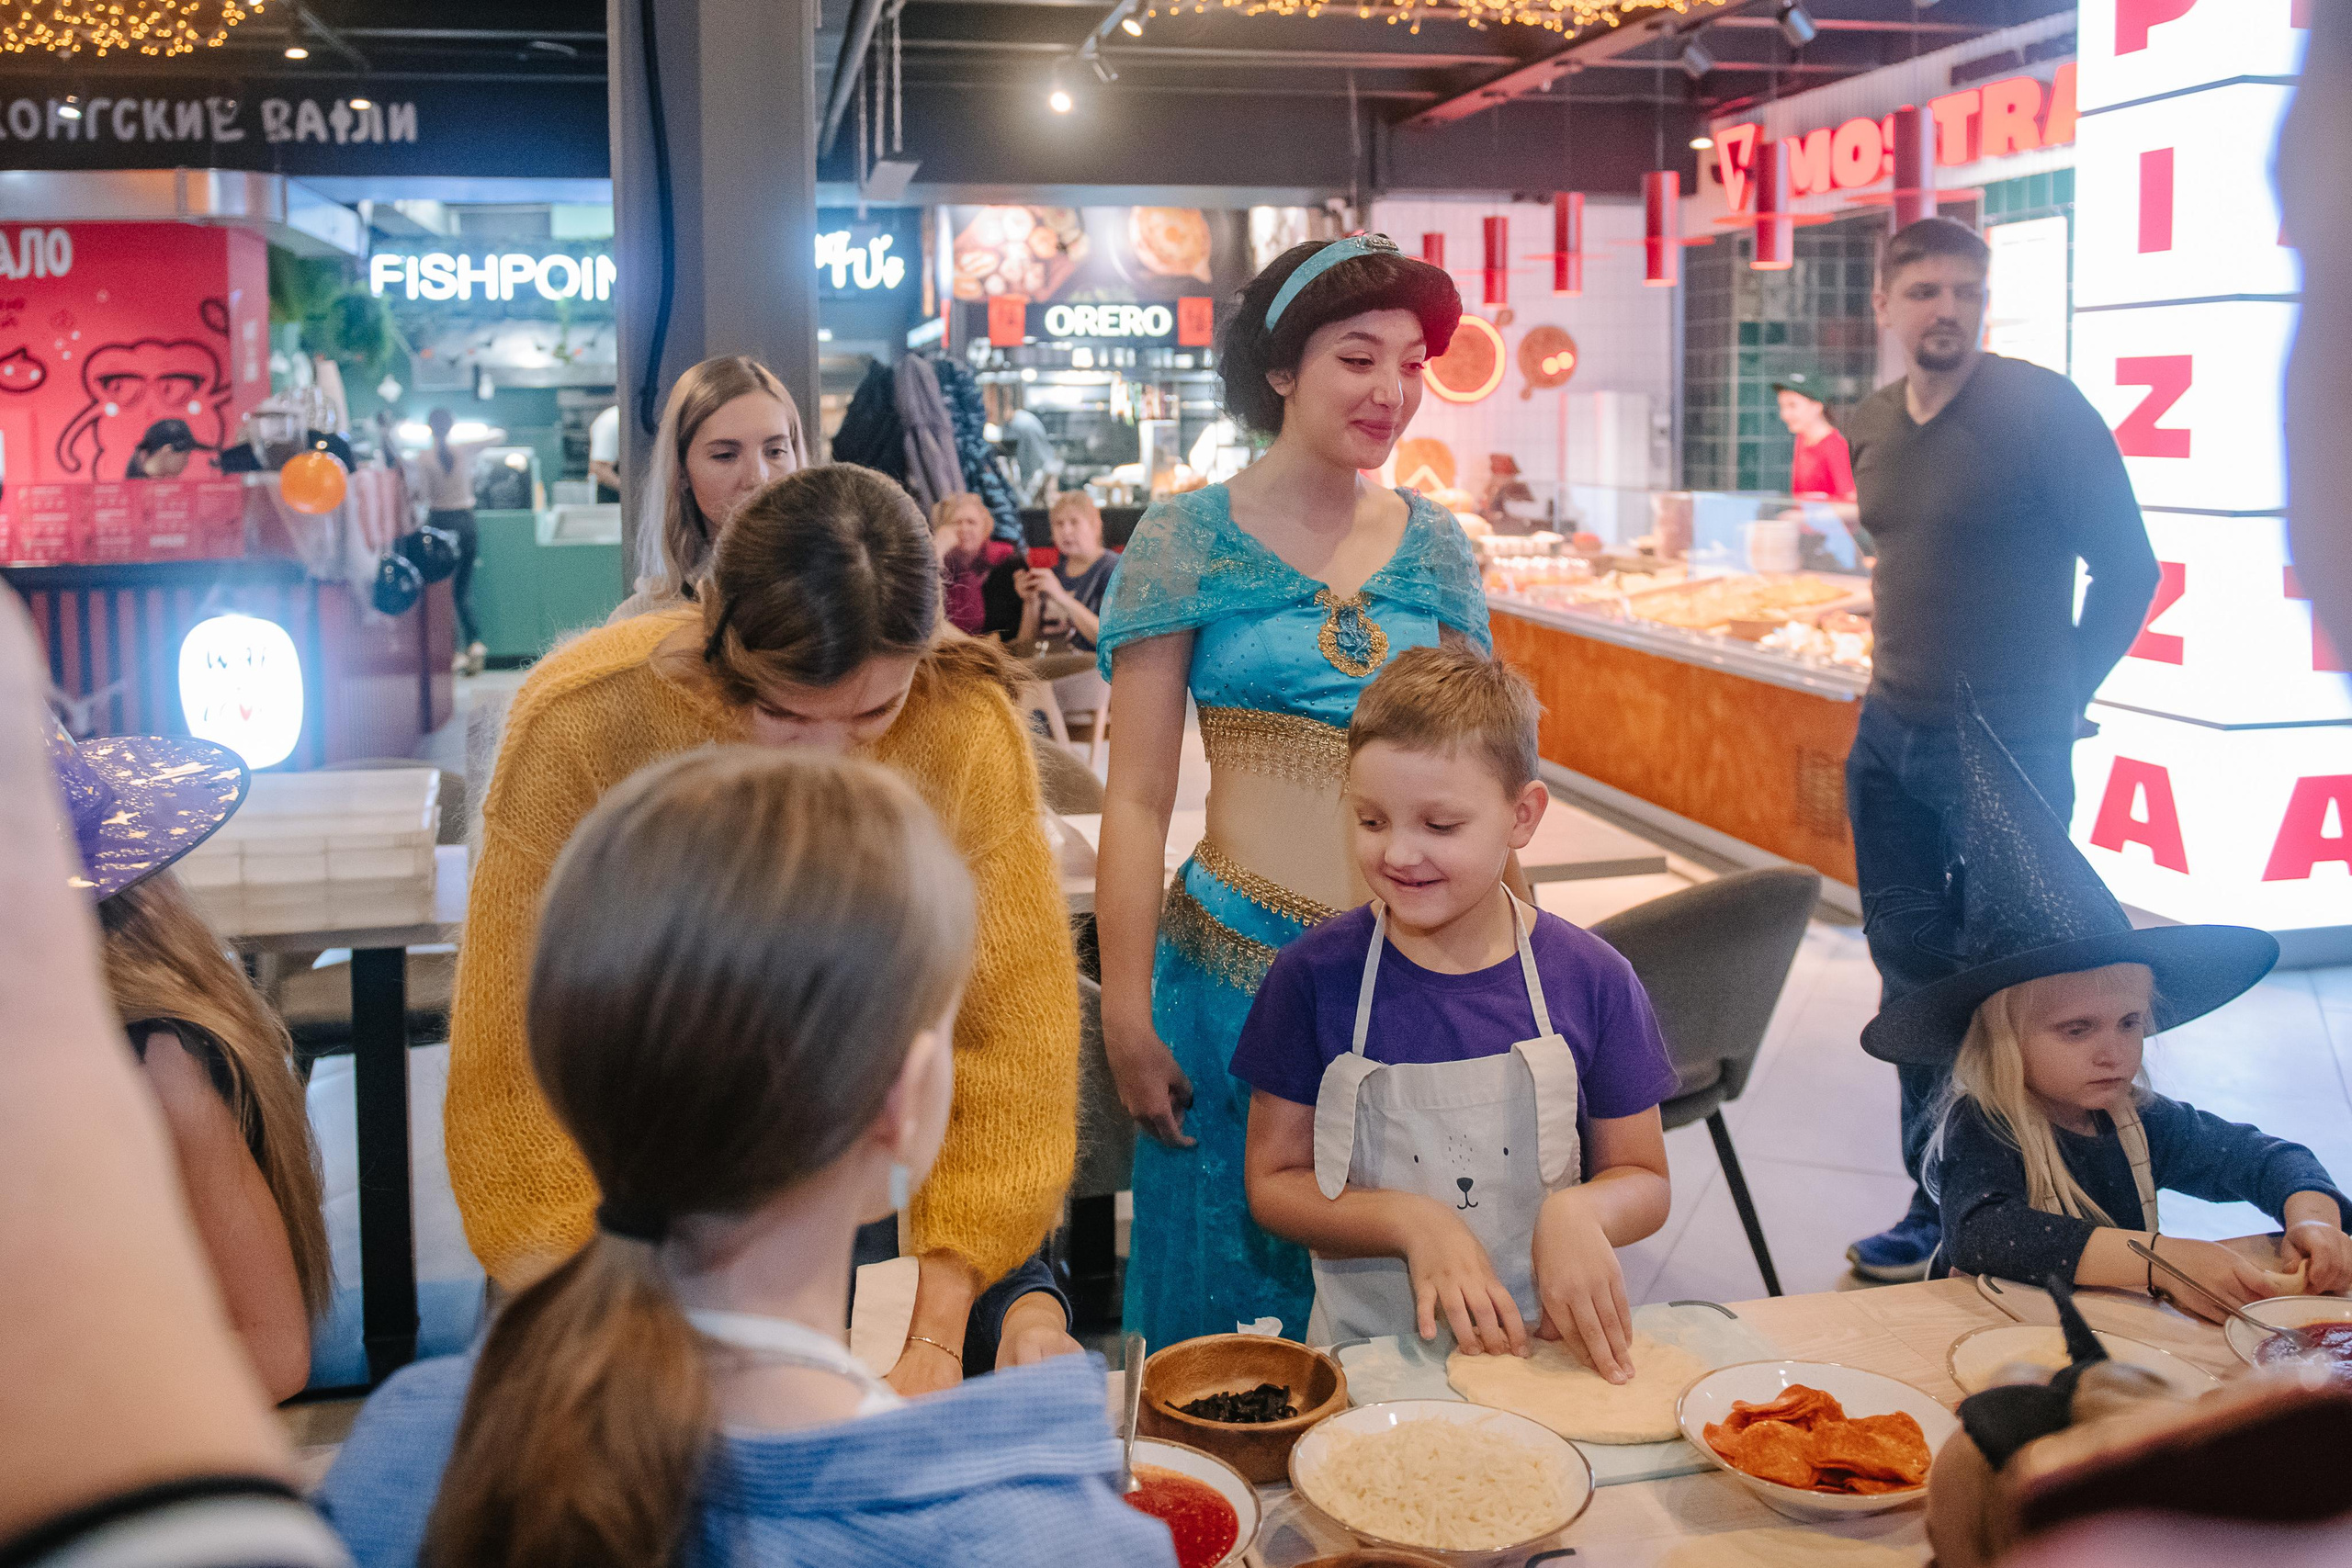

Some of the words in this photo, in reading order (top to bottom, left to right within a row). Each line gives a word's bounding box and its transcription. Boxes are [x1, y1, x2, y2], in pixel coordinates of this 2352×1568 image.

[0, 97, 245, 142] ОНГСКИЕ
[260, 98, 418, 145] ВАФЛИ
[1044, 304, 1173, 337] ORERO
